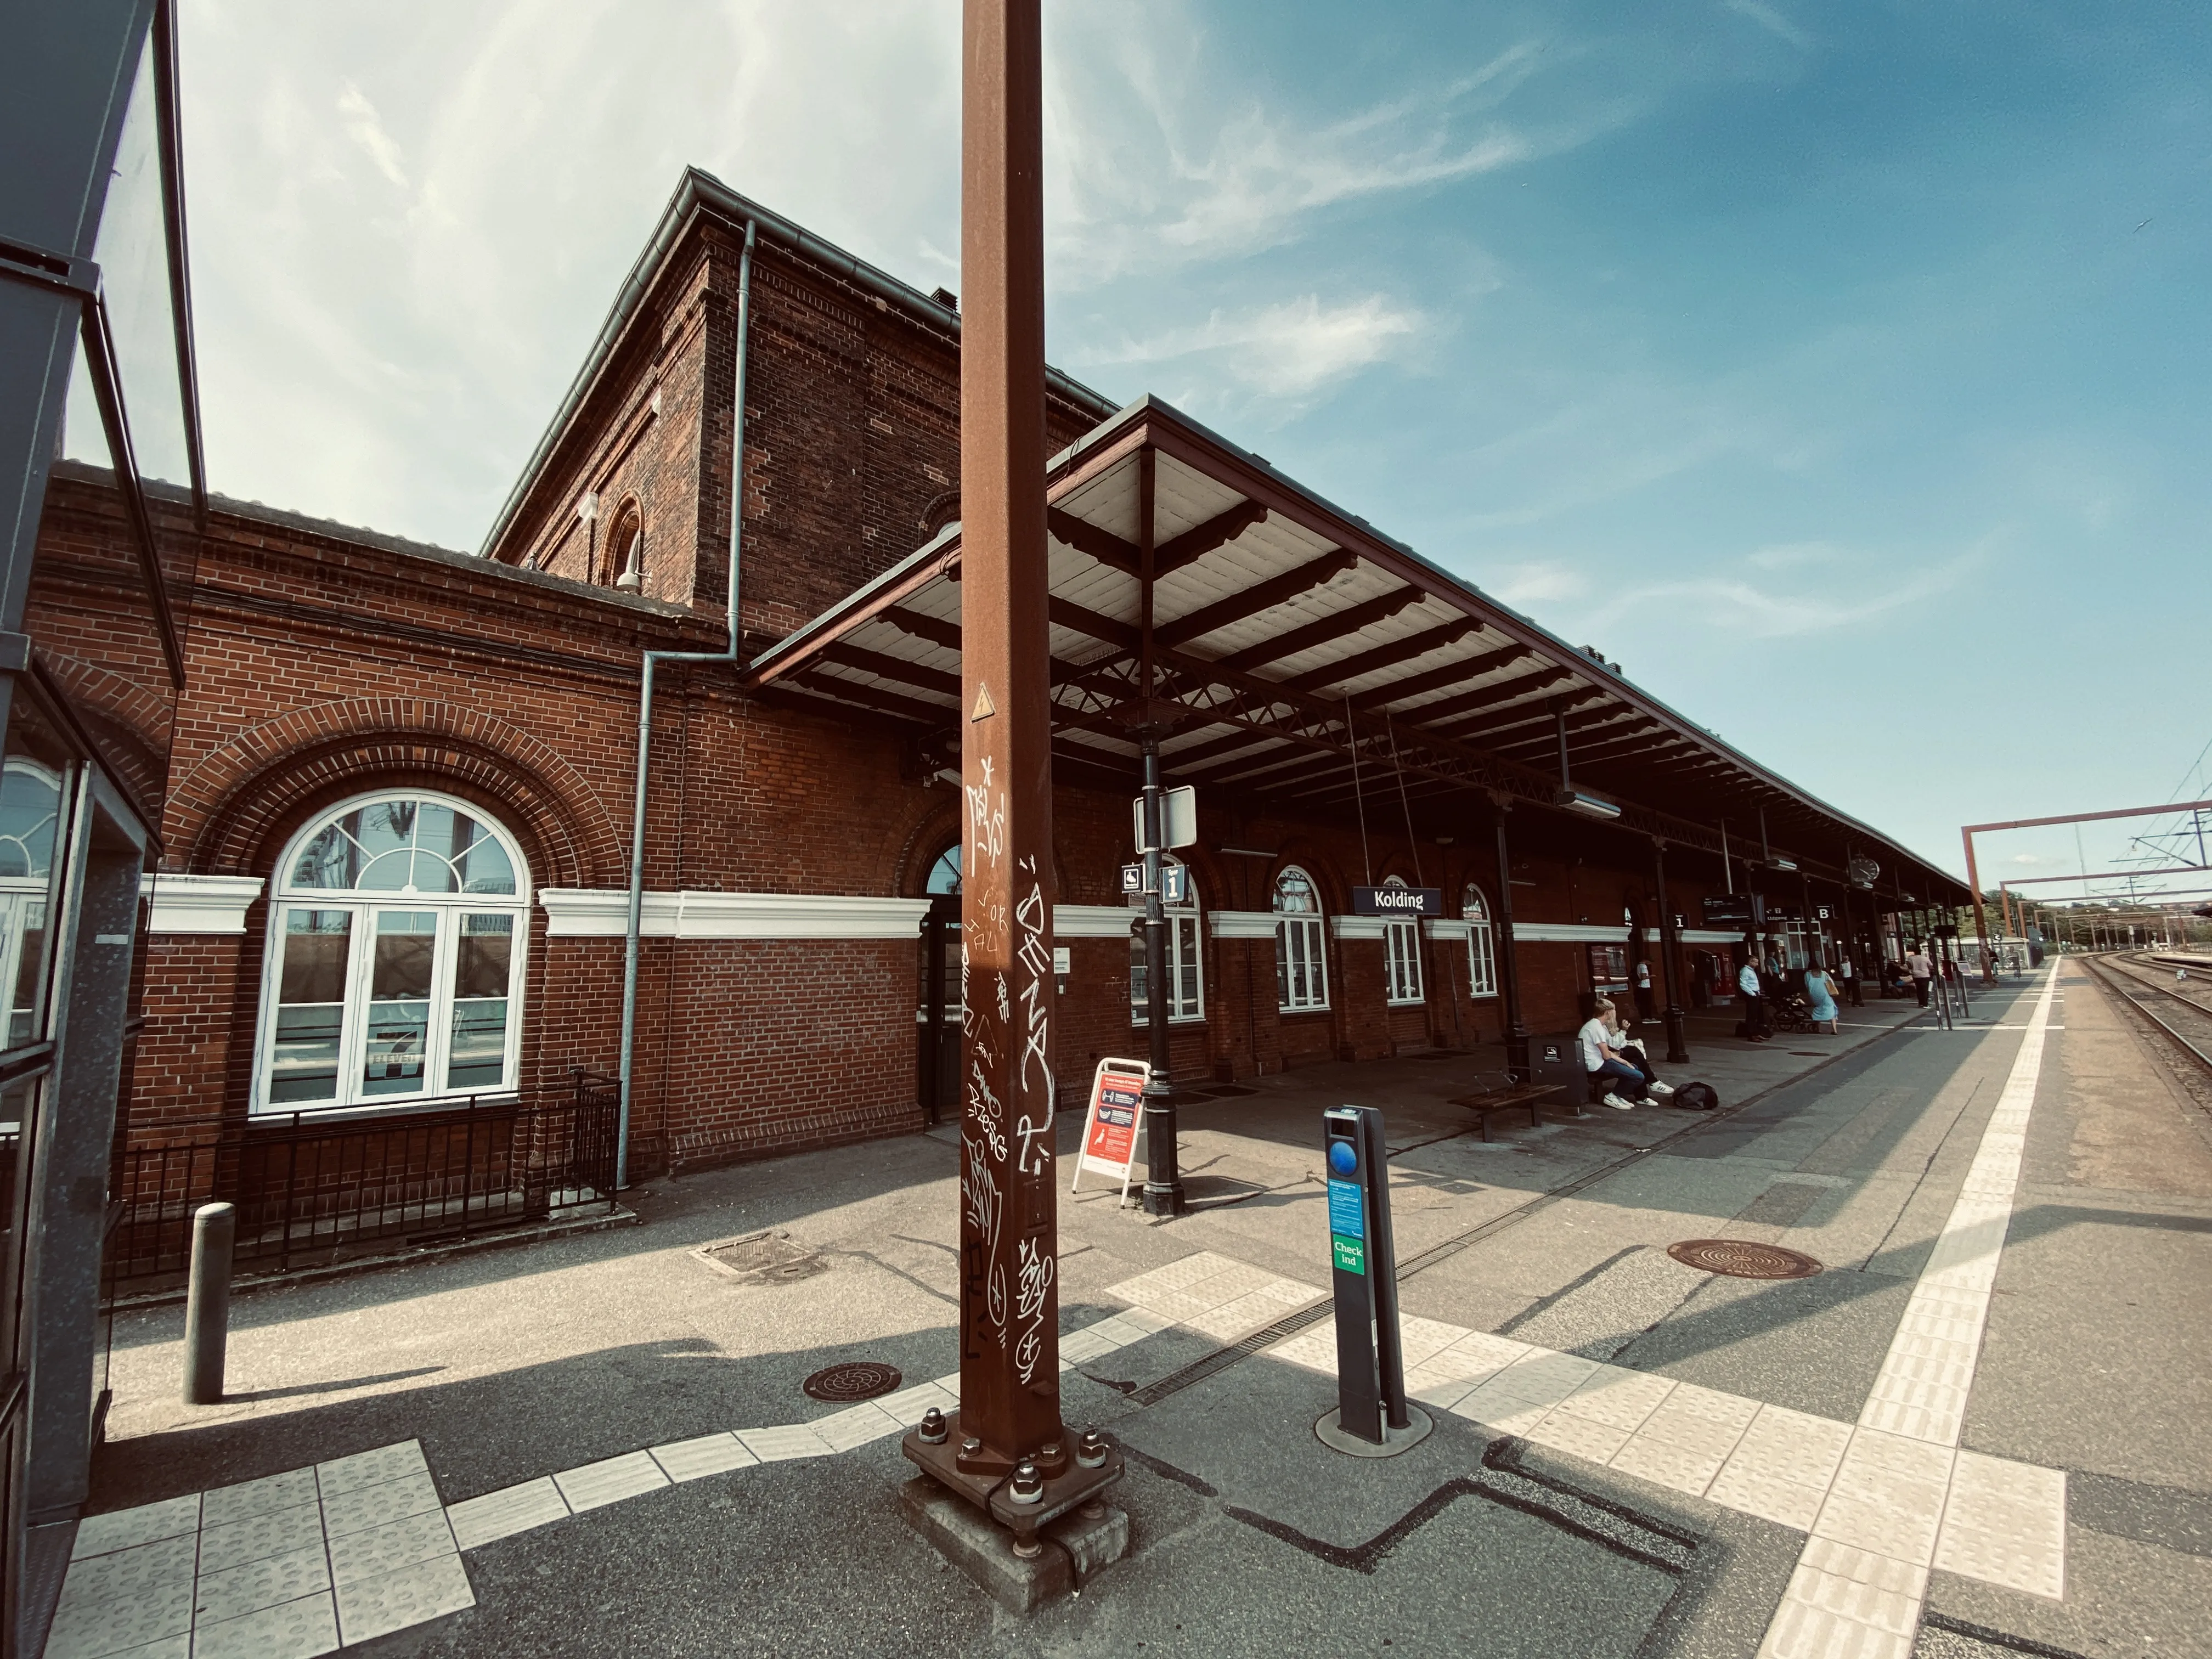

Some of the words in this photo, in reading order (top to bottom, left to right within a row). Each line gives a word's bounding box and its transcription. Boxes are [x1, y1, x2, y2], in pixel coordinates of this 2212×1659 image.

[1169, 877, 1178, 898] 1
[1374, 891, 1424, 911] Kolding
[1819, 909, 1829, 918] B
[1676, 918, 1684, 927] 1
[1335, 1242, 1362, 1256] Check
[1342, 1254, 1356, 1266] ind
